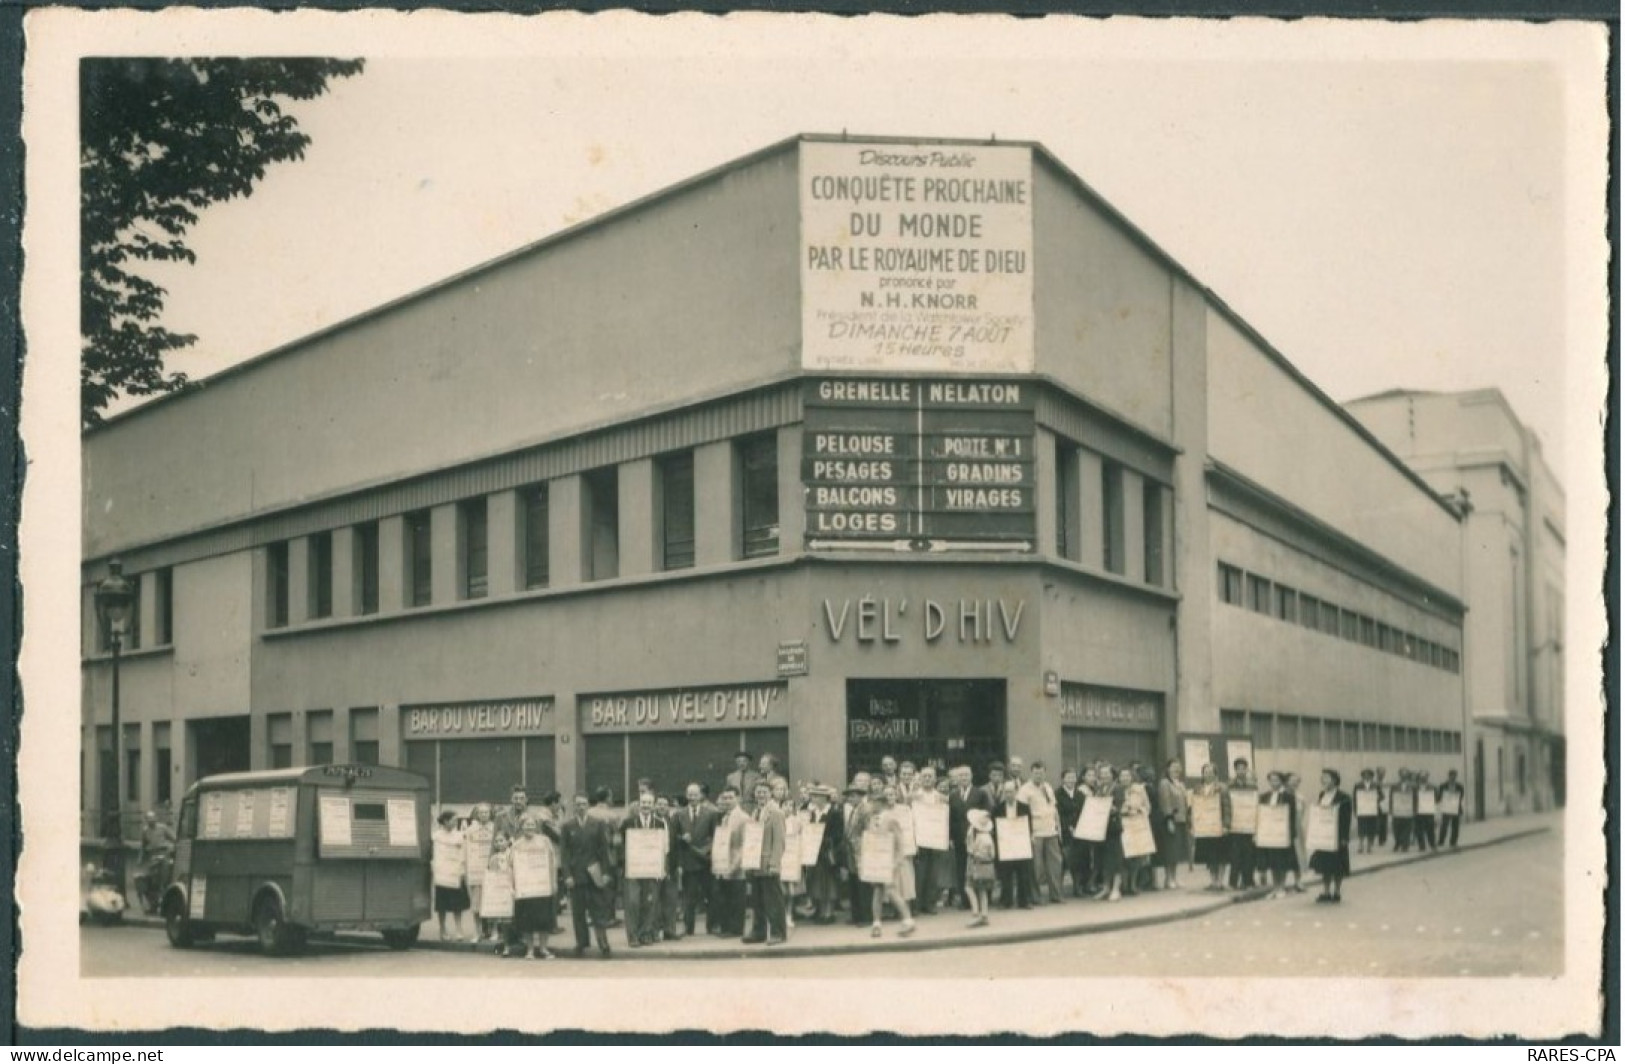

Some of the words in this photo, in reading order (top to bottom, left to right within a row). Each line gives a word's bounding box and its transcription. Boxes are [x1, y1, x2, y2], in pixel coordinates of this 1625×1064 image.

[859, 150, 928, 167] Discours
[929, 152, 977, 168] Public
[811, 174, 916, 206] CONQUÊTE
[924, 178, 1027, 204] PROCHAINE
[850, 213, 880, 237] DU
[899, 214, 983, 238] MONDE
[808, 246, 843, 271] PAR
[849, 247, 869, 271] LE
[873, 248, 954, 273] ROYAUME
[958, 250, 980, 273] DE
[985, 250, 1026, 274] DIEU
[936, 278, 957, 289] par
[828, 321, 942, 341] DIMANCHE
[949, 325, 961, 342] 7
[819, 381, 911, 401] GRENELLE
[930, 385, 1020, 404] NELATON
[816, 435, 894, 454] PELOUSE
[1014, 438, 1021, 456] 1
[814, 461, 892, 479] PESAGES
[947, 464, 1023, 482] GRADINS
[816, 487, 896, 505] BALCONS
[946, 490, 1022, 507] VIRAGES
[818, 512, 896, 530] LOGES
[411, 709, 440, 732] BAR
[442, 707, 462, 731] DU
[590, 698, 629, 726] BAR
[634, 697, 660, 722] DU
